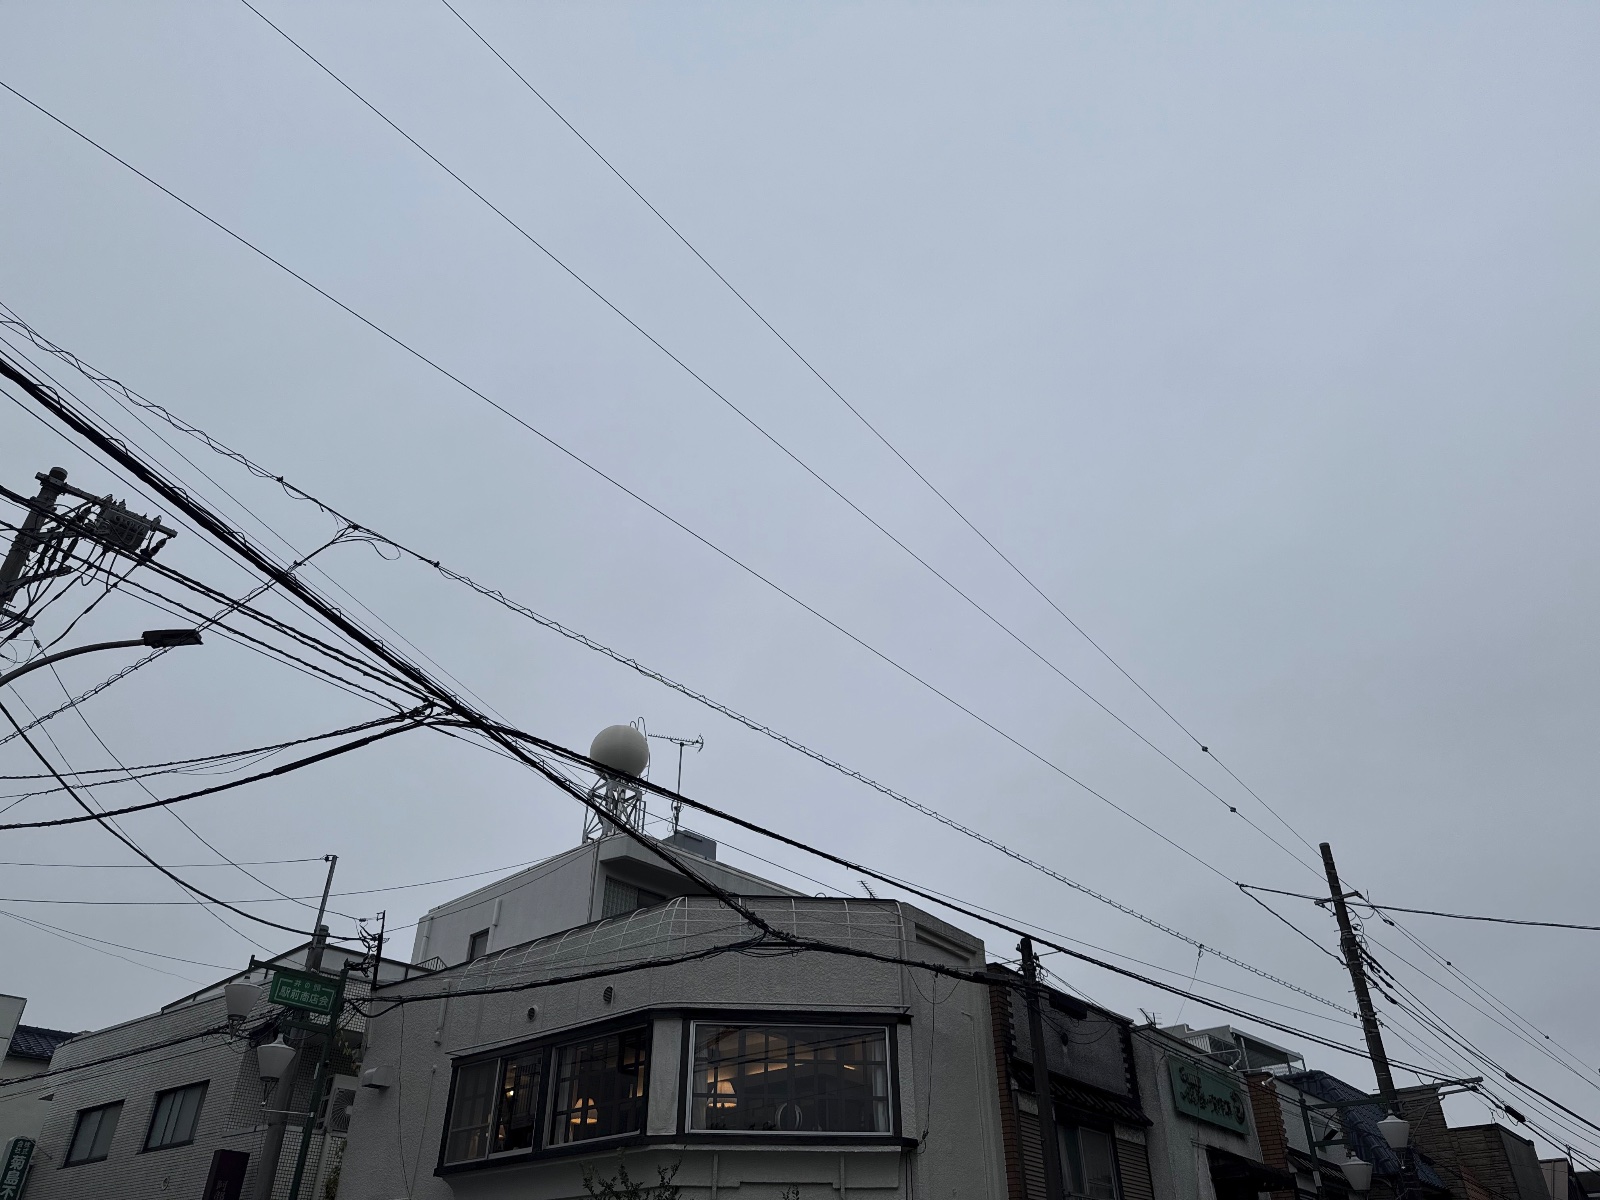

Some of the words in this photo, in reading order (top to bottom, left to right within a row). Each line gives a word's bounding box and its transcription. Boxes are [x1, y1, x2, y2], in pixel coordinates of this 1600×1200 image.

[278, 985, 329, 1007] 駅前商店会
